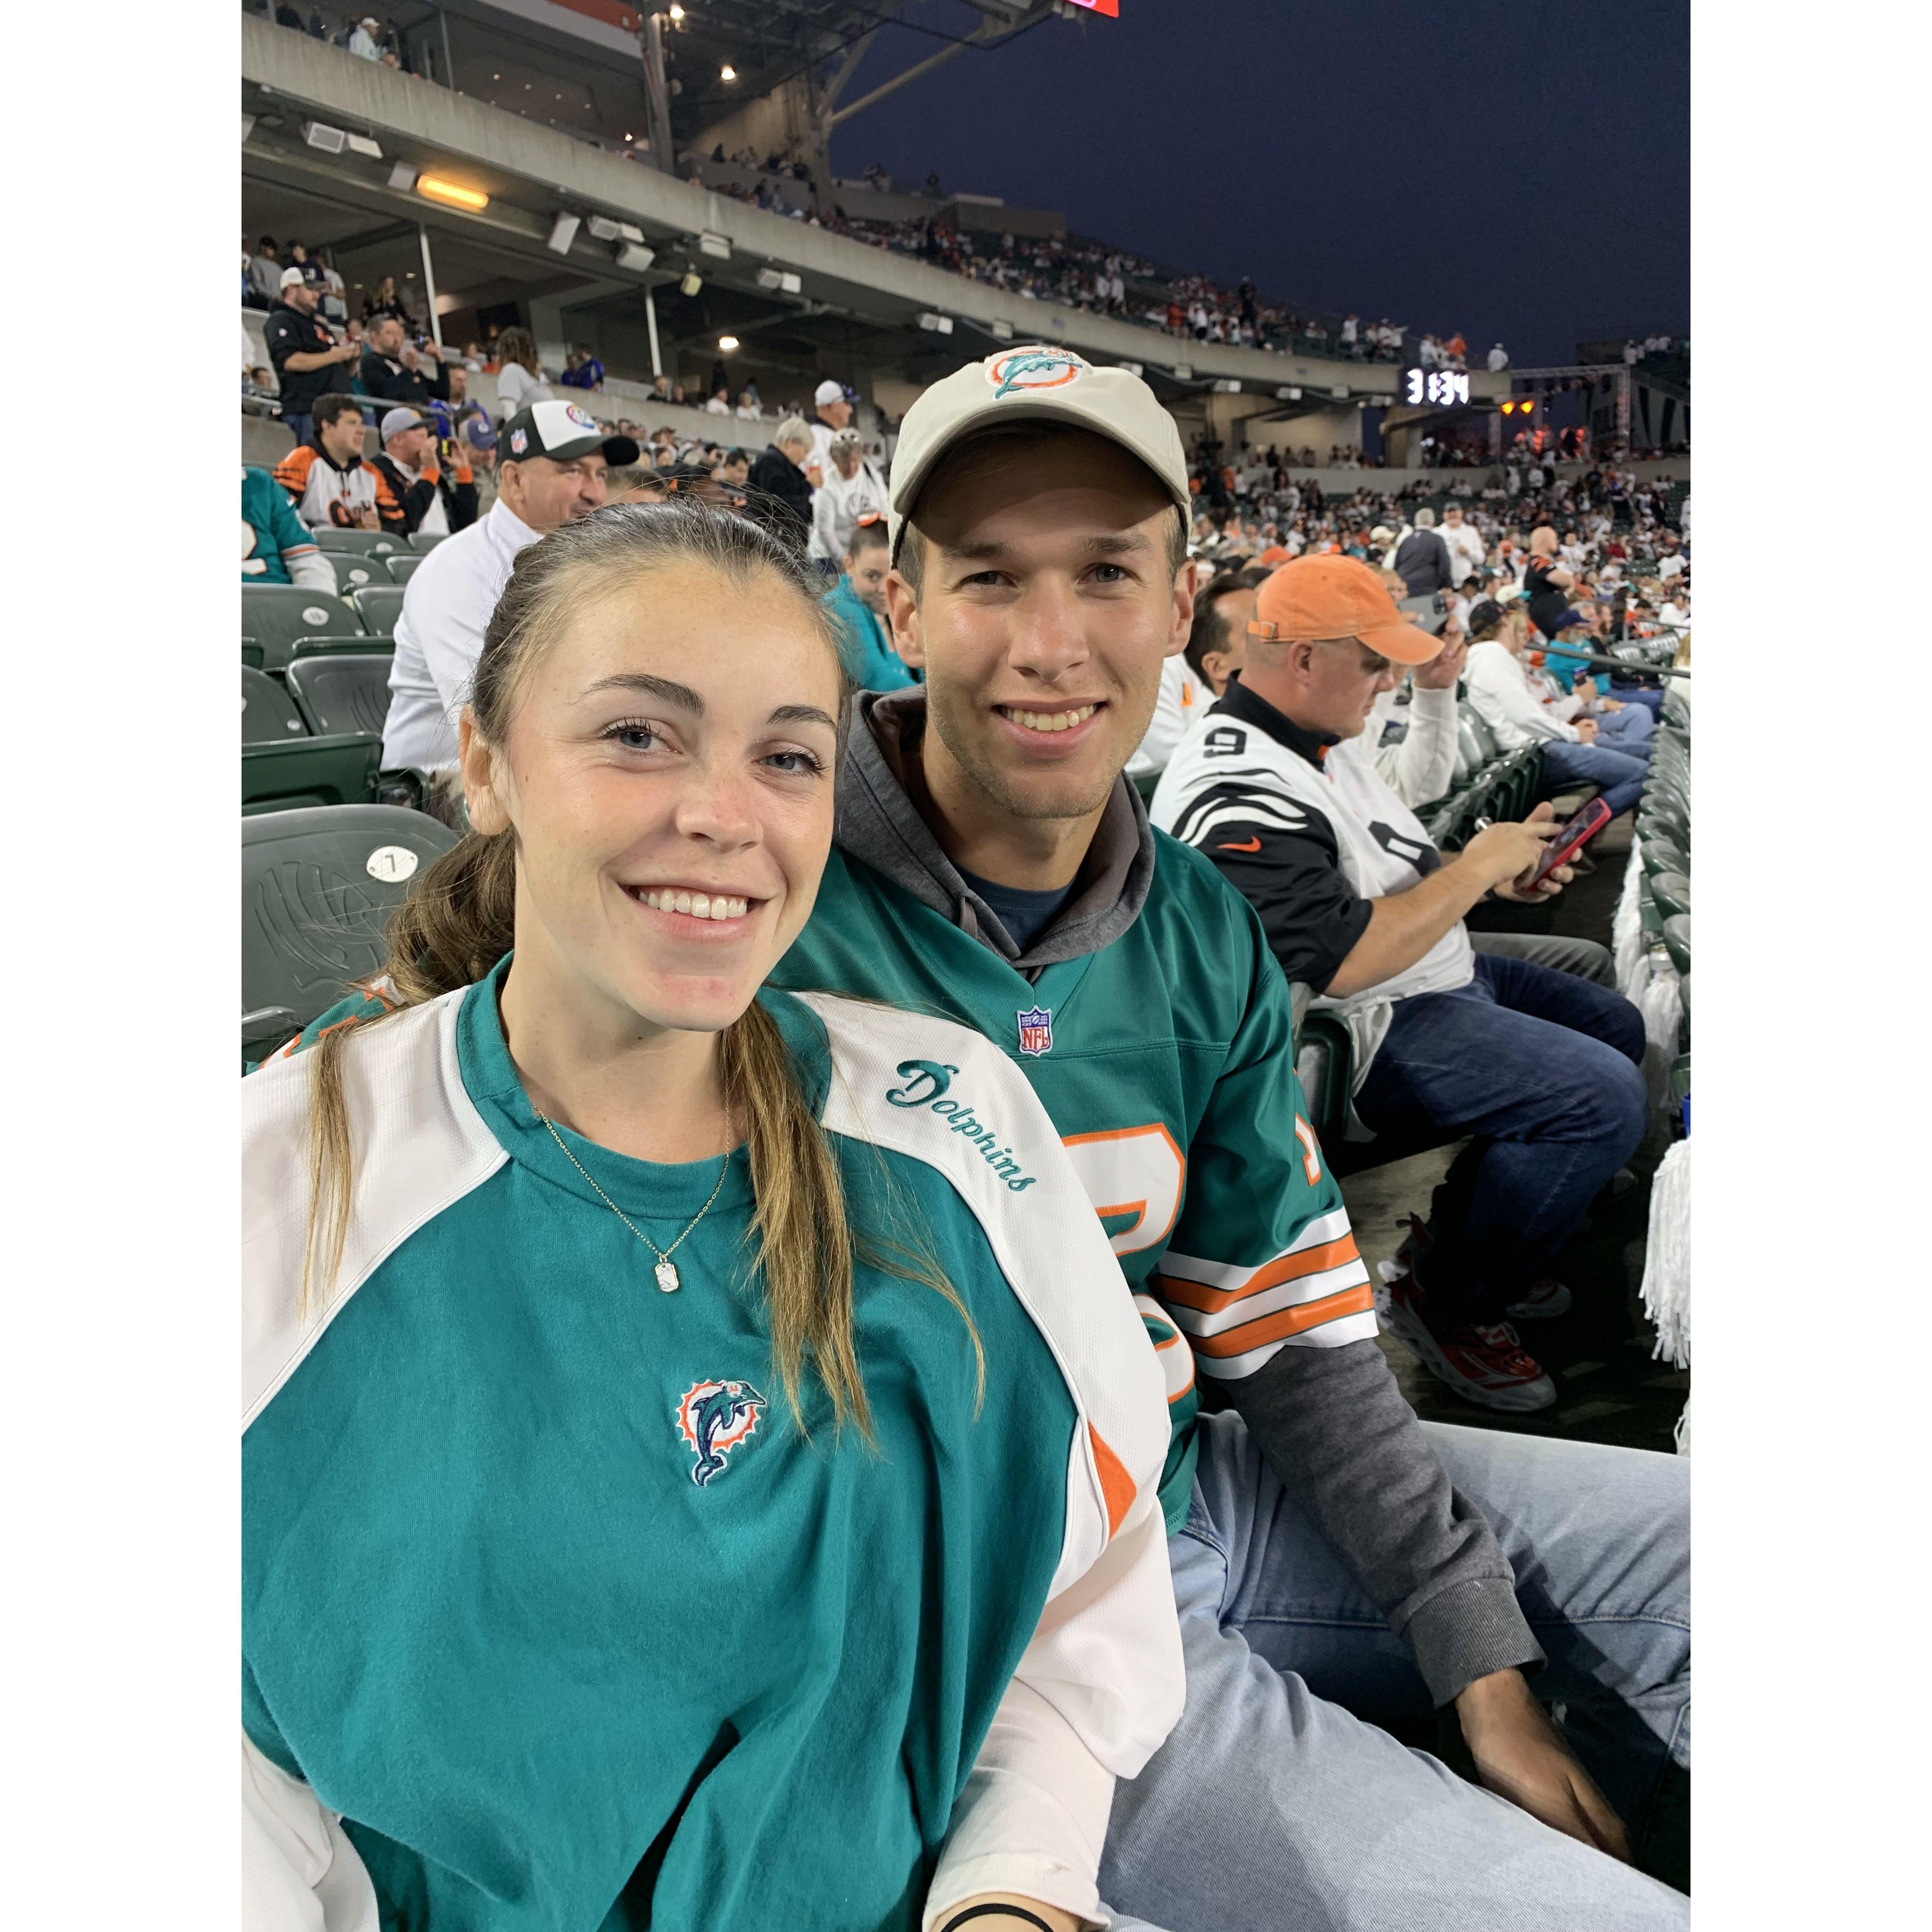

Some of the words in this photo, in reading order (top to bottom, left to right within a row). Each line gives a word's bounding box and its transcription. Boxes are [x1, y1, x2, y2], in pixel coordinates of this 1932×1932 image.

[1407, 368, 1469, 405] 31:34
[1203, 726, 1247, 759] 9
[1022, 1026, 1049, 1050] NFL
[886, 1059, 1036, 1191] Dolphins
